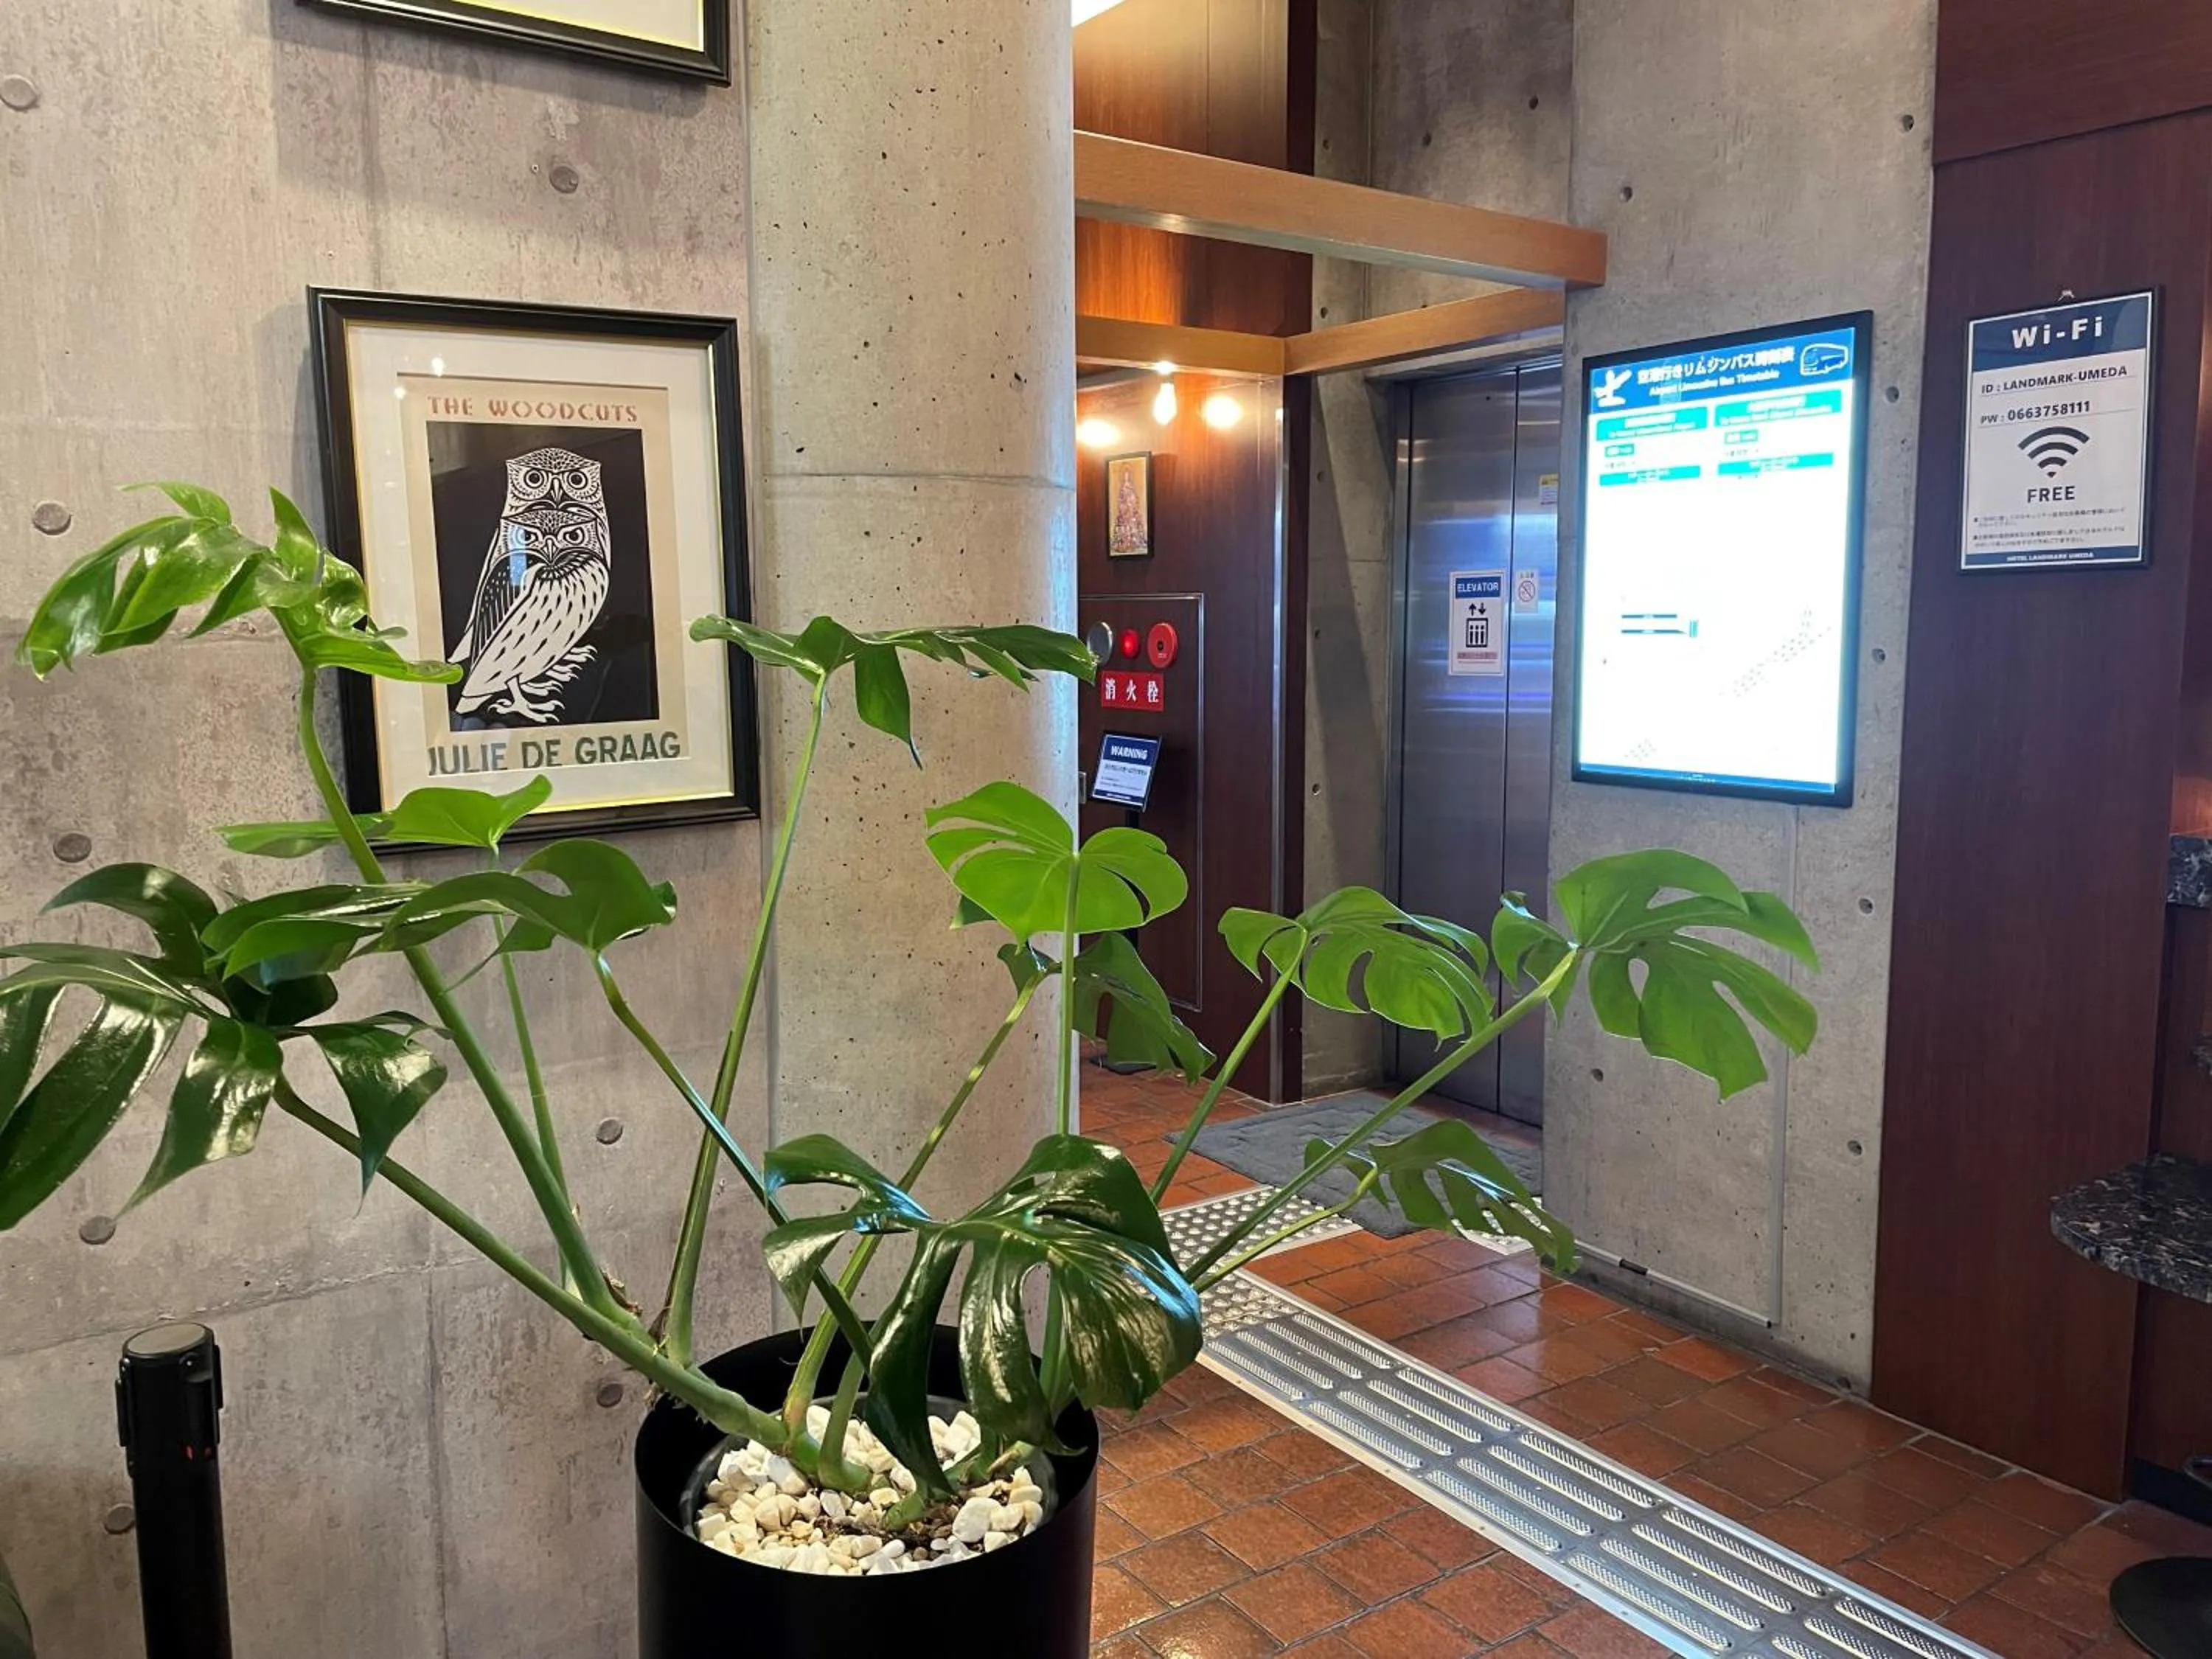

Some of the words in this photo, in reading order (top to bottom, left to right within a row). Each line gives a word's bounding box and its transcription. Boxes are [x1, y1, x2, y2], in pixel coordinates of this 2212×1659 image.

[2011, 316, 2103, 349] Wi-Fi
[1981, 383, 1993, 394] ID
[2003, 365, 2128, 391] LANDMARK-UMEDA
[428, 397, 473, 416] THE
[488, 399, 639, 422] WOODCUTS
[1980, 414, 1998, 424] PW
[2007, 400, 2091, 422] 0663758111
[2027, 485, 2076, 504] FREE
[1456, 581, 1500, 593] ELEVATOR
[1105, 677, 1159, 703] 消火栓
[427, 742, 508, 776] JULIE
[521, 740, 563, 770] DE
[574, 731, 681, 764] GRAAG
[1110, 745, 1149, 761] WARNING
